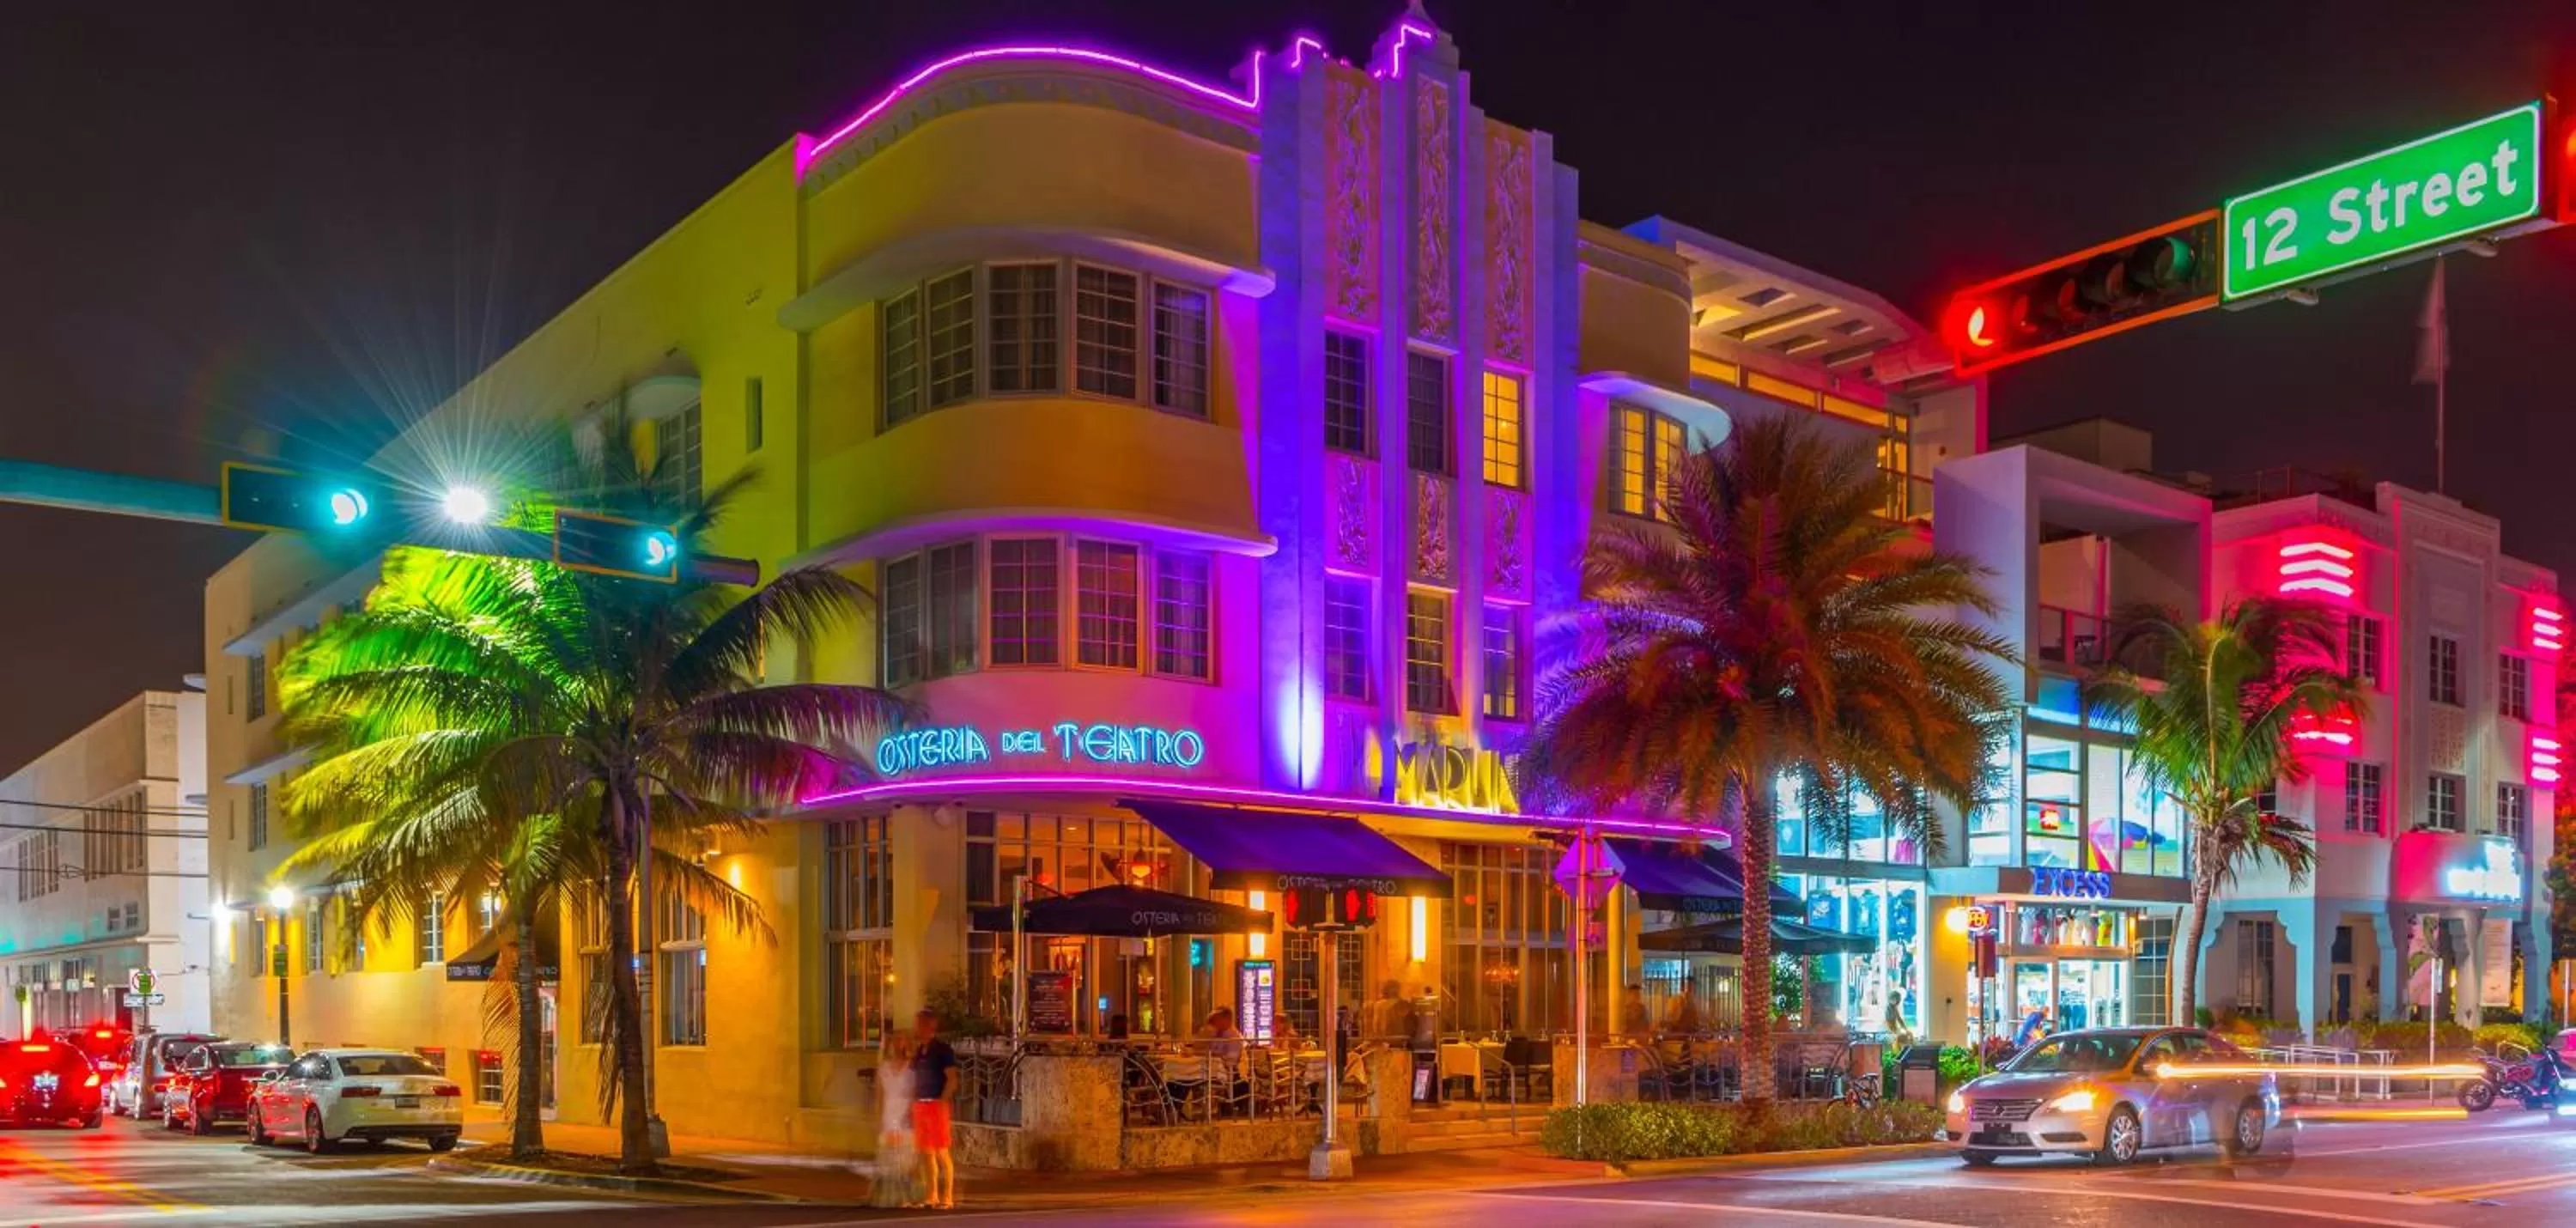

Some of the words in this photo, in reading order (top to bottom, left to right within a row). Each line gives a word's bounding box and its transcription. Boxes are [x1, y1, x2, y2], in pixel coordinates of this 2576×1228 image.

[2242, 207, 2299, 271] 12
[2326, 139, 2518, 245] Street
[878, 725, 990, 775] OSTERIA
[1001, 731, 1045, 753] DEL
[1054, 723, 1203, 768] TEATRO
[2032, 866, 2110, 897] EXCESS
